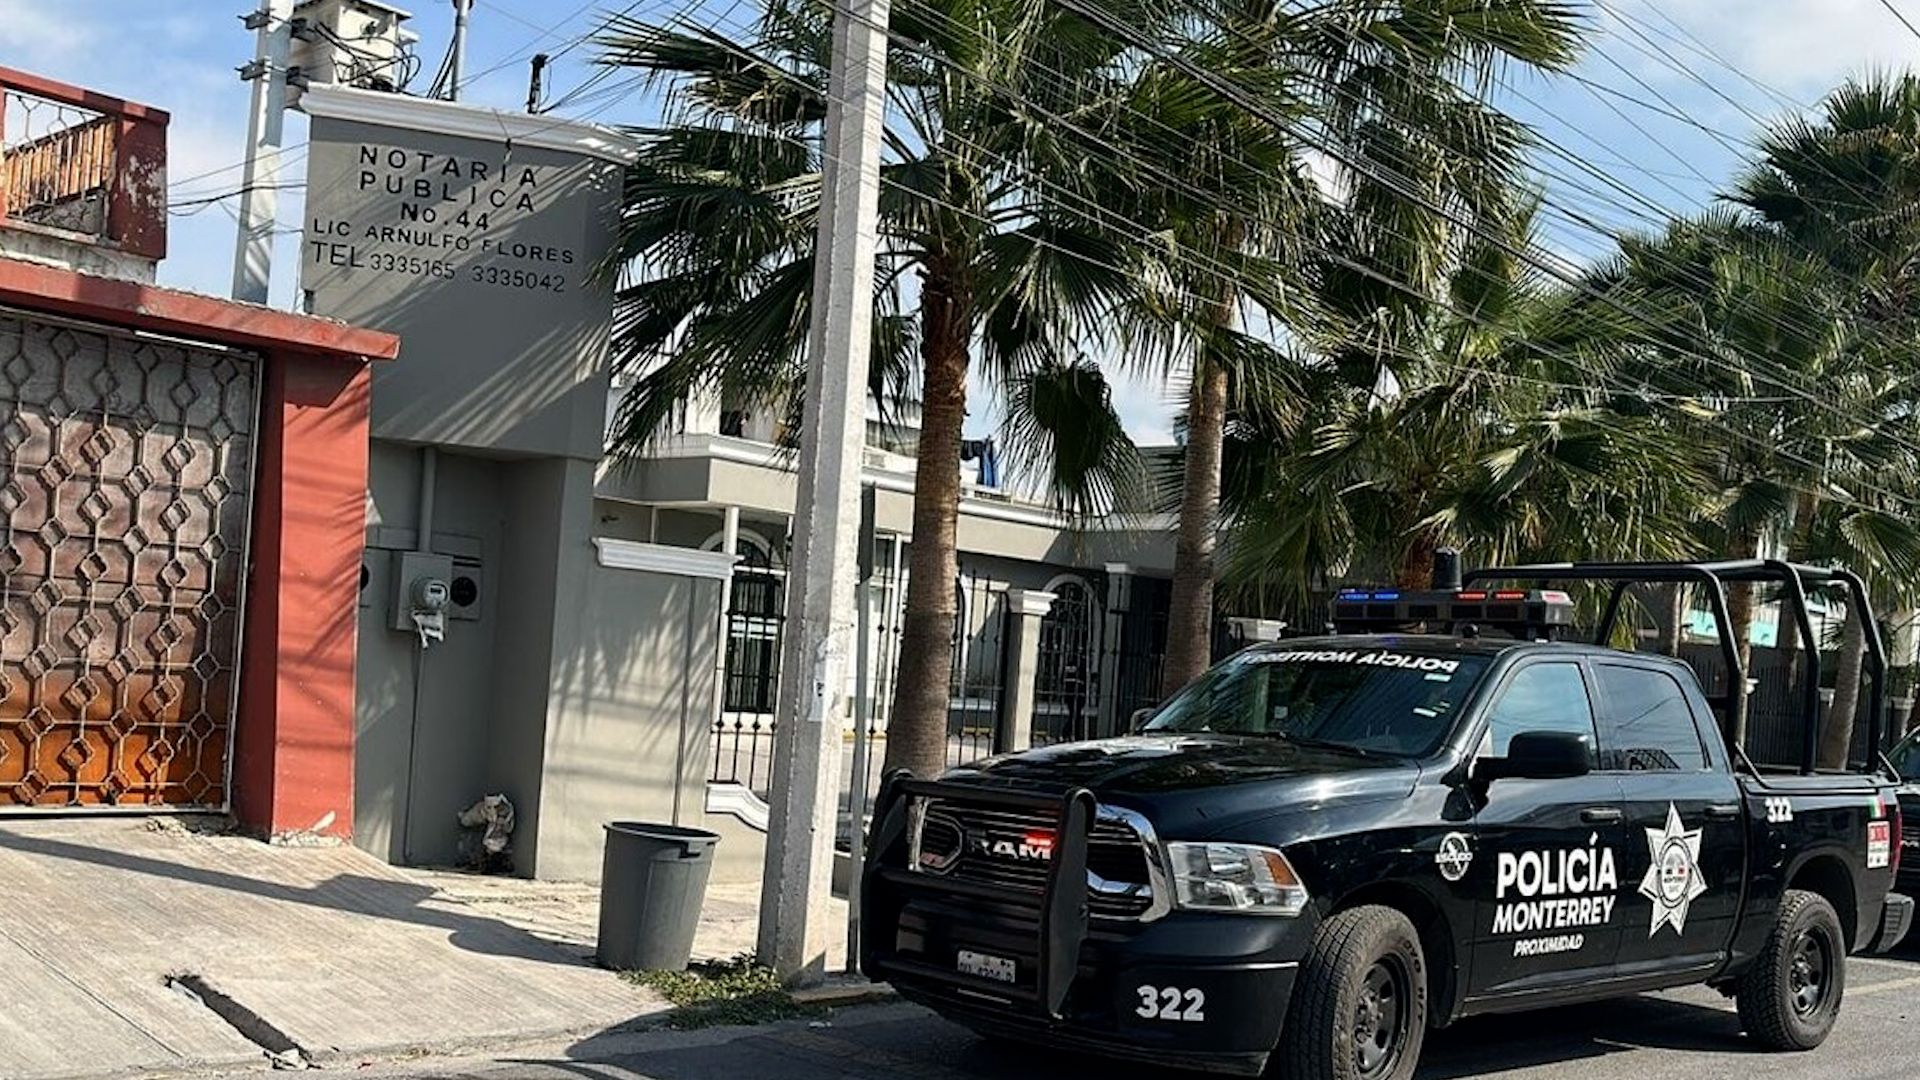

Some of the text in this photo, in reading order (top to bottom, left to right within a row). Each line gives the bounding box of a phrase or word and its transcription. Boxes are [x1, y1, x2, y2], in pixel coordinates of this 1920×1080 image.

[359, 171, 534, 212] PUBLICA
[313, 218, 574, 264] LIC ARNULFO FLORES
[310, 240, 565, 293] TEL 3335165 3335042
[1765, 796, 1794, 823] 322
[1496, 831, 1618, 899] POLICÍA
[1492, 895, 1616, 934] MONTERREY
[1513, 933, 1584, 957] PROXIMIDAD
[1135, 985, 1205, 1022] 322
